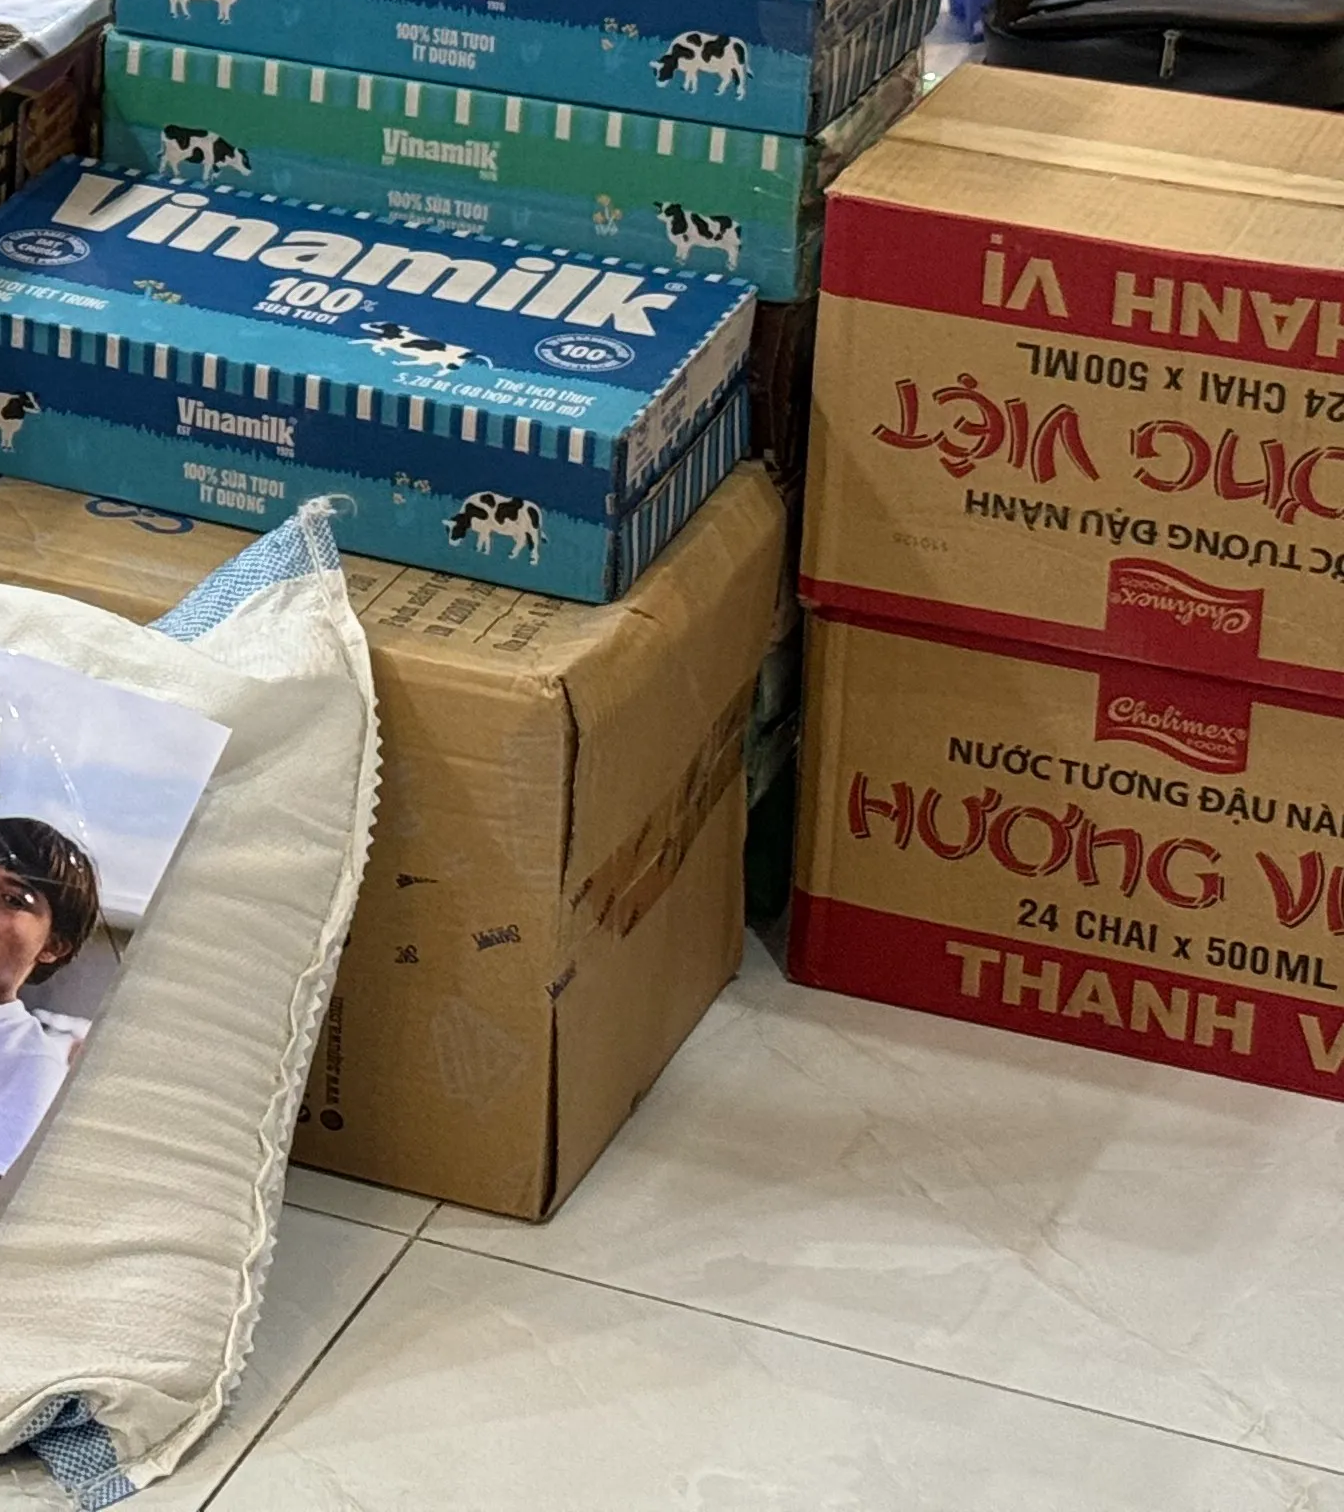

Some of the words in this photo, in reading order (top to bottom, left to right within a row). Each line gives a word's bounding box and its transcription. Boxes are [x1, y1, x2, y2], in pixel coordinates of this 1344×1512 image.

[395, 23, 431, 43] 100%
[381, 127, 500, 173] Vinamilk
[51, 172, 678, 337] Vinamilk
[982, 233, 1069, 319] VỊ
[1016, 341, 1149, 394] 500ML
[1164, 364, 1185, 390] x
[1199, 371, 1287, 415] CHAI
[177, 396, 296, 448] Vinamilk
[871, 372, 1101, 485] VIỆT
[182, 461, 219, 486] 100%
[964, 488, 1070, 533] NÀNH
[1079, 506, 1158, 546] ĐẬU
[1167, 523, 1303, 573] TƯƠNG
[1117, 586, 1254, 635] Cholimex
[1107, 696, 1238, 744] Cholimex
[947, 735, 1054, 781] NƯỚC
[1058, 758, 1191, 808] TƯƠNG
[1196, 785, 1278, 827] ĐẬU
[847, 771, 1227, 911] HƯƠNG
[1017, 898, 1059, 933] 24
[1074, 909, 1159, 955] CHAI
[1172, 934, 1192, 961] x
[1205, 936, 1340, 992] 500ML
[944, 939, 1256, 1057] THANH
